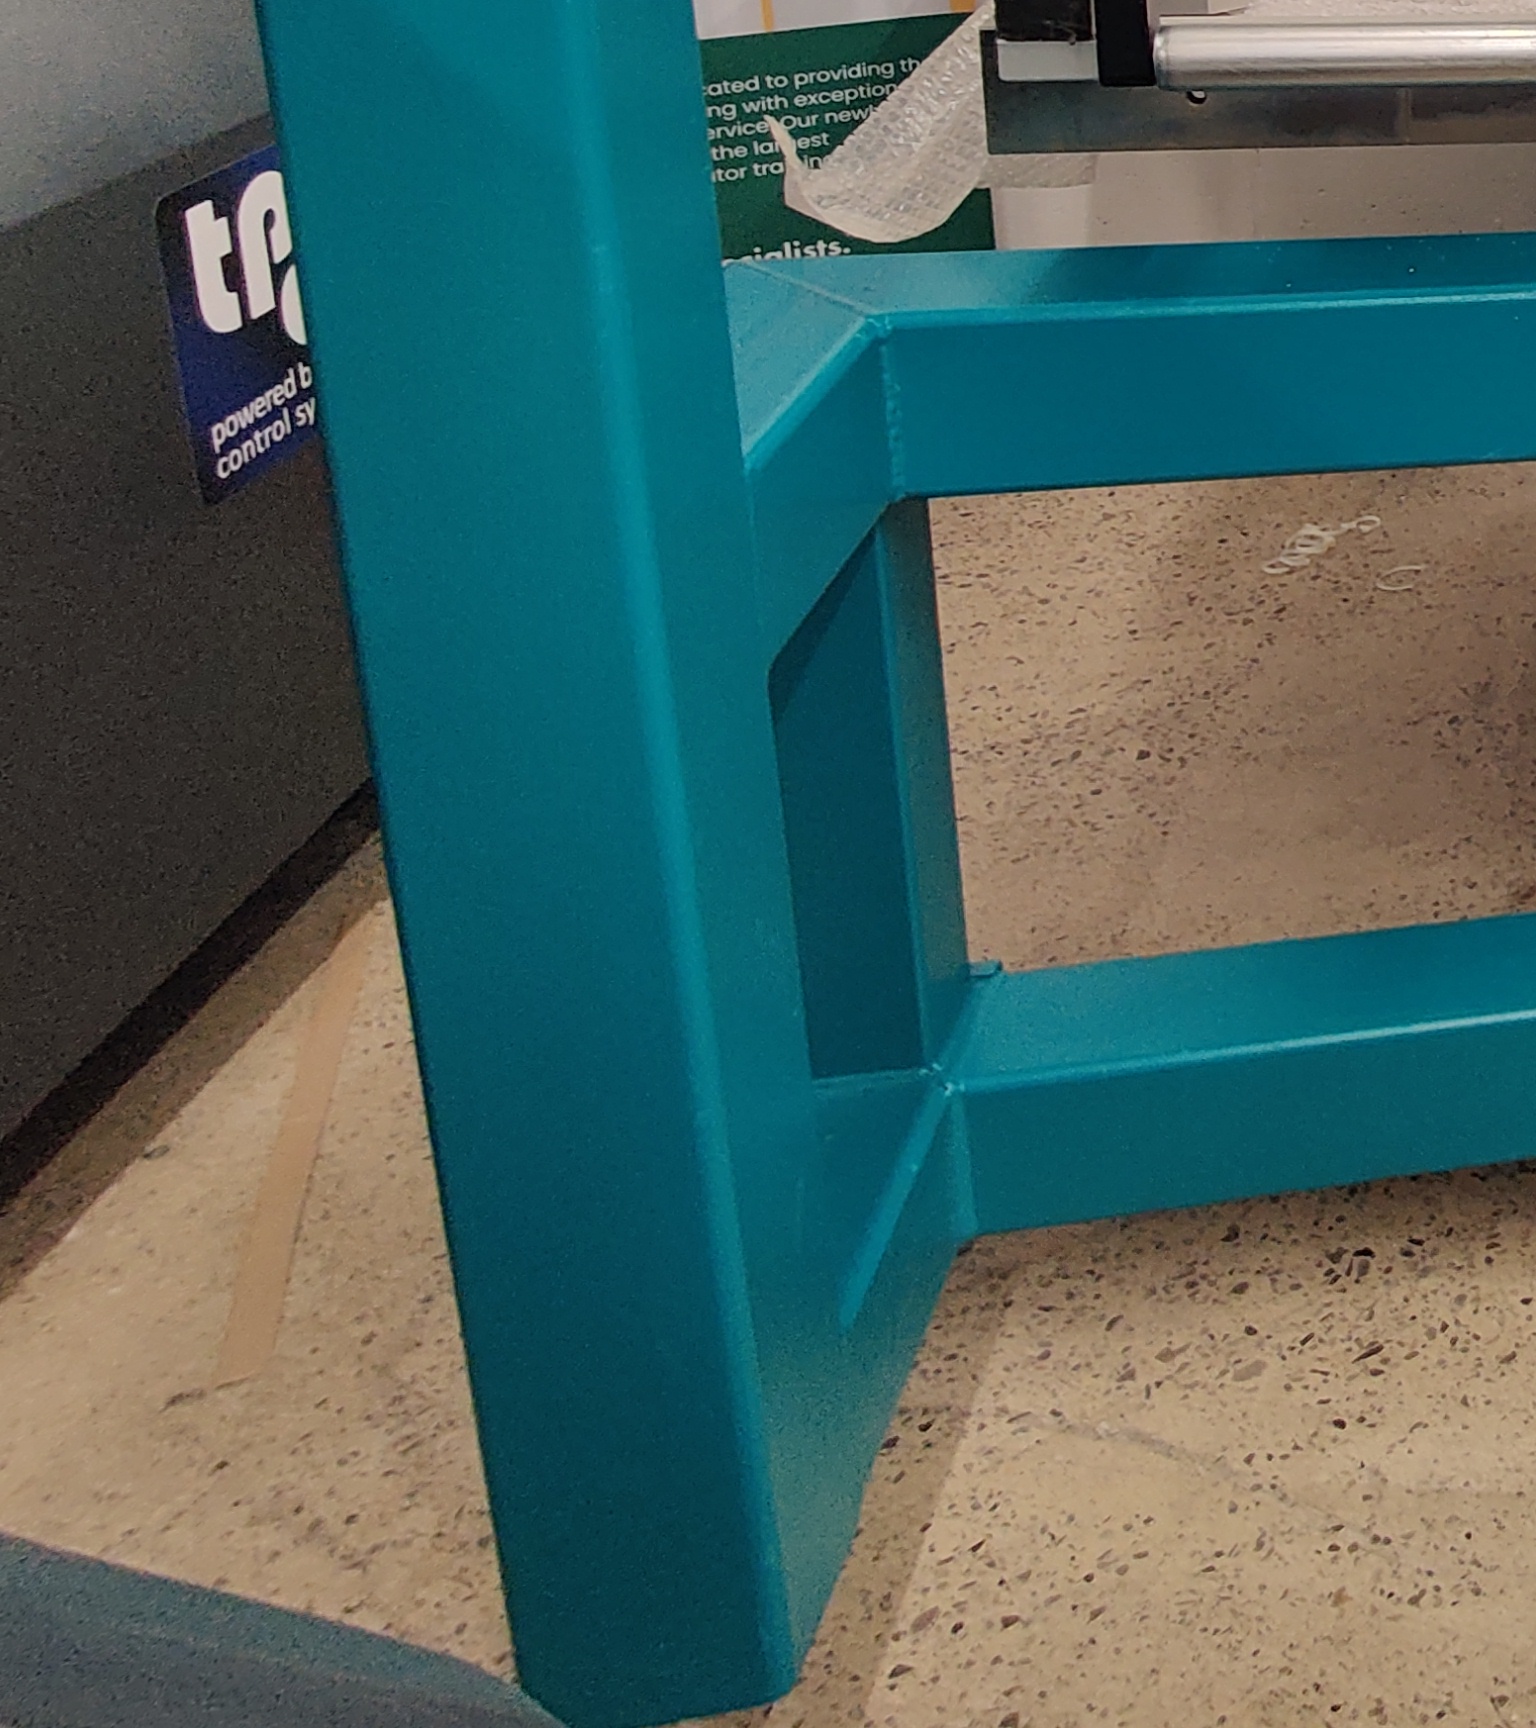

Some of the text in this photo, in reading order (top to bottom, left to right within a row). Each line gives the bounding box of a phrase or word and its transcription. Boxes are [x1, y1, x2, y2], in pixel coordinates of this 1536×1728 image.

[702, 75, 760, 96] ated
[765, 74, 789, 90] to
[793, 62, 896, 90] providing
[741, 94, 789, 113] with
[793, 82, 897, 107] exception
[780, 114, 820, 130] Our
[710, 145, 749, 161] the
[711, 167, 748, 183] tor
[211, 368, 298, 453] powered
[216, 407, 292, 480] control
